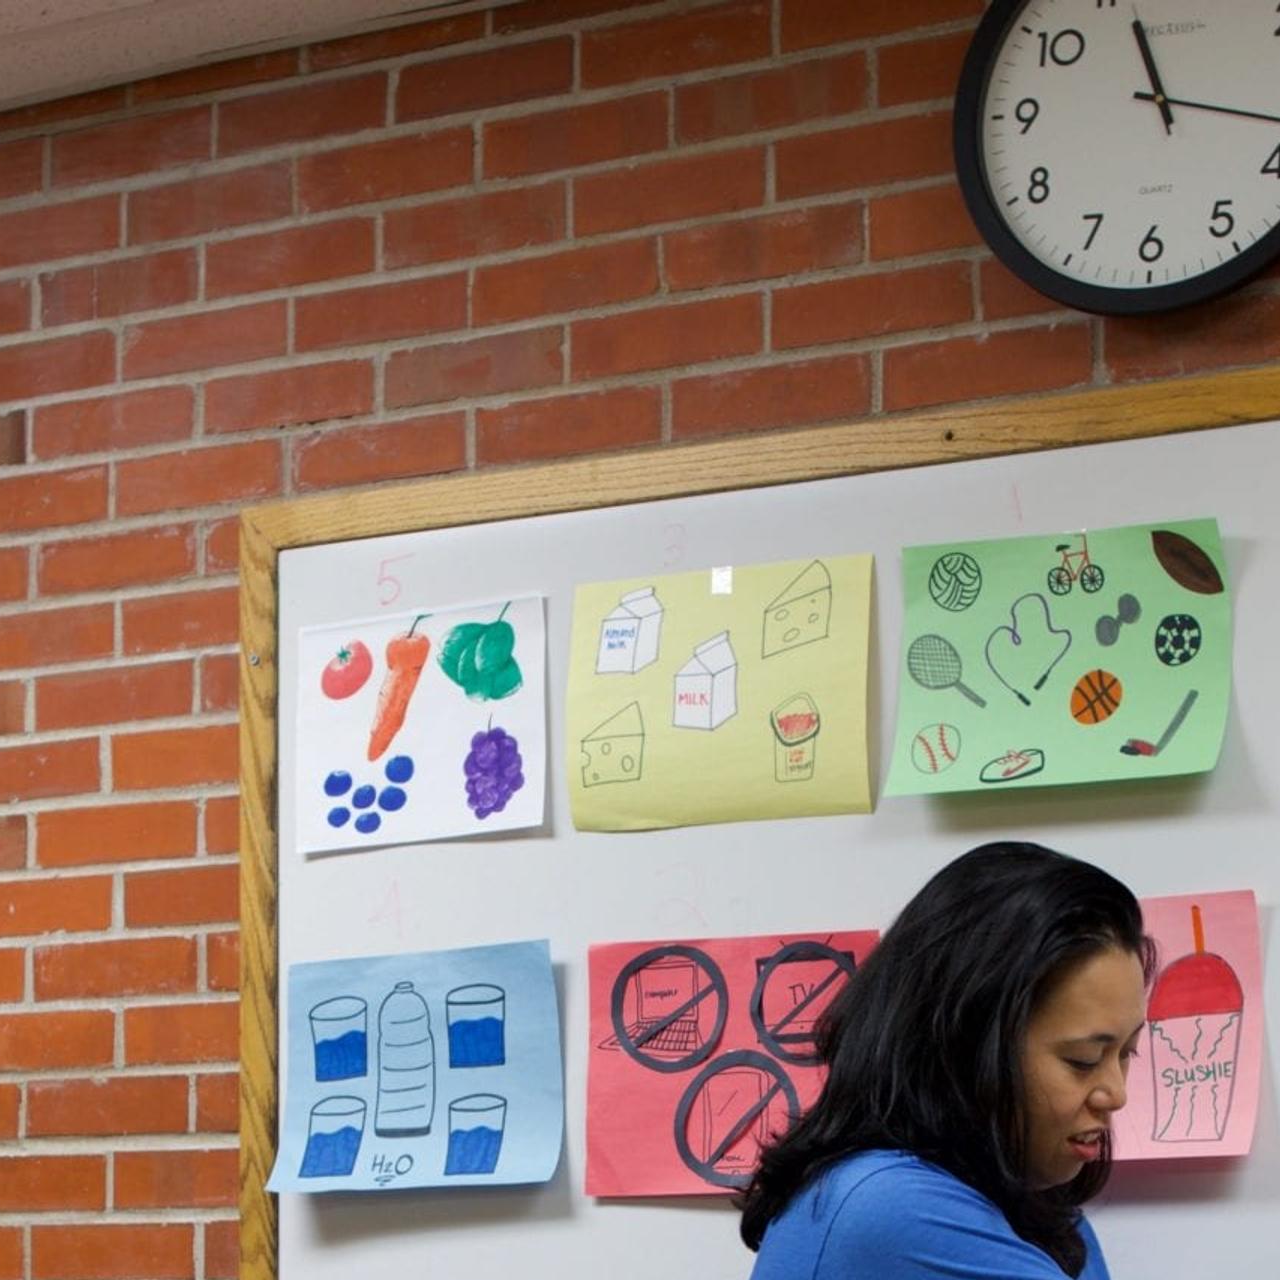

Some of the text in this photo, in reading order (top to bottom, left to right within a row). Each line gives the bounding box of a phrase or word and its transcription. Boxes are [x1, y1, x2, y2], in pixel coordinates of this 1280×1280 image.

[1038, 29, 1085, 67] 10
[1015, 98, 1039, 134] 9
[1027, 167, 1049, 203] 8
[1082, 213, 1104, 250] 7
[1209, 200, 1234, 238] 5
[1139, 225, 1163, 262] 6
[376, 552, 416, 606] 5
[678, 692, 709, 706] MILK
[1161, 1061, 1232, 1088] SLUSHIE
